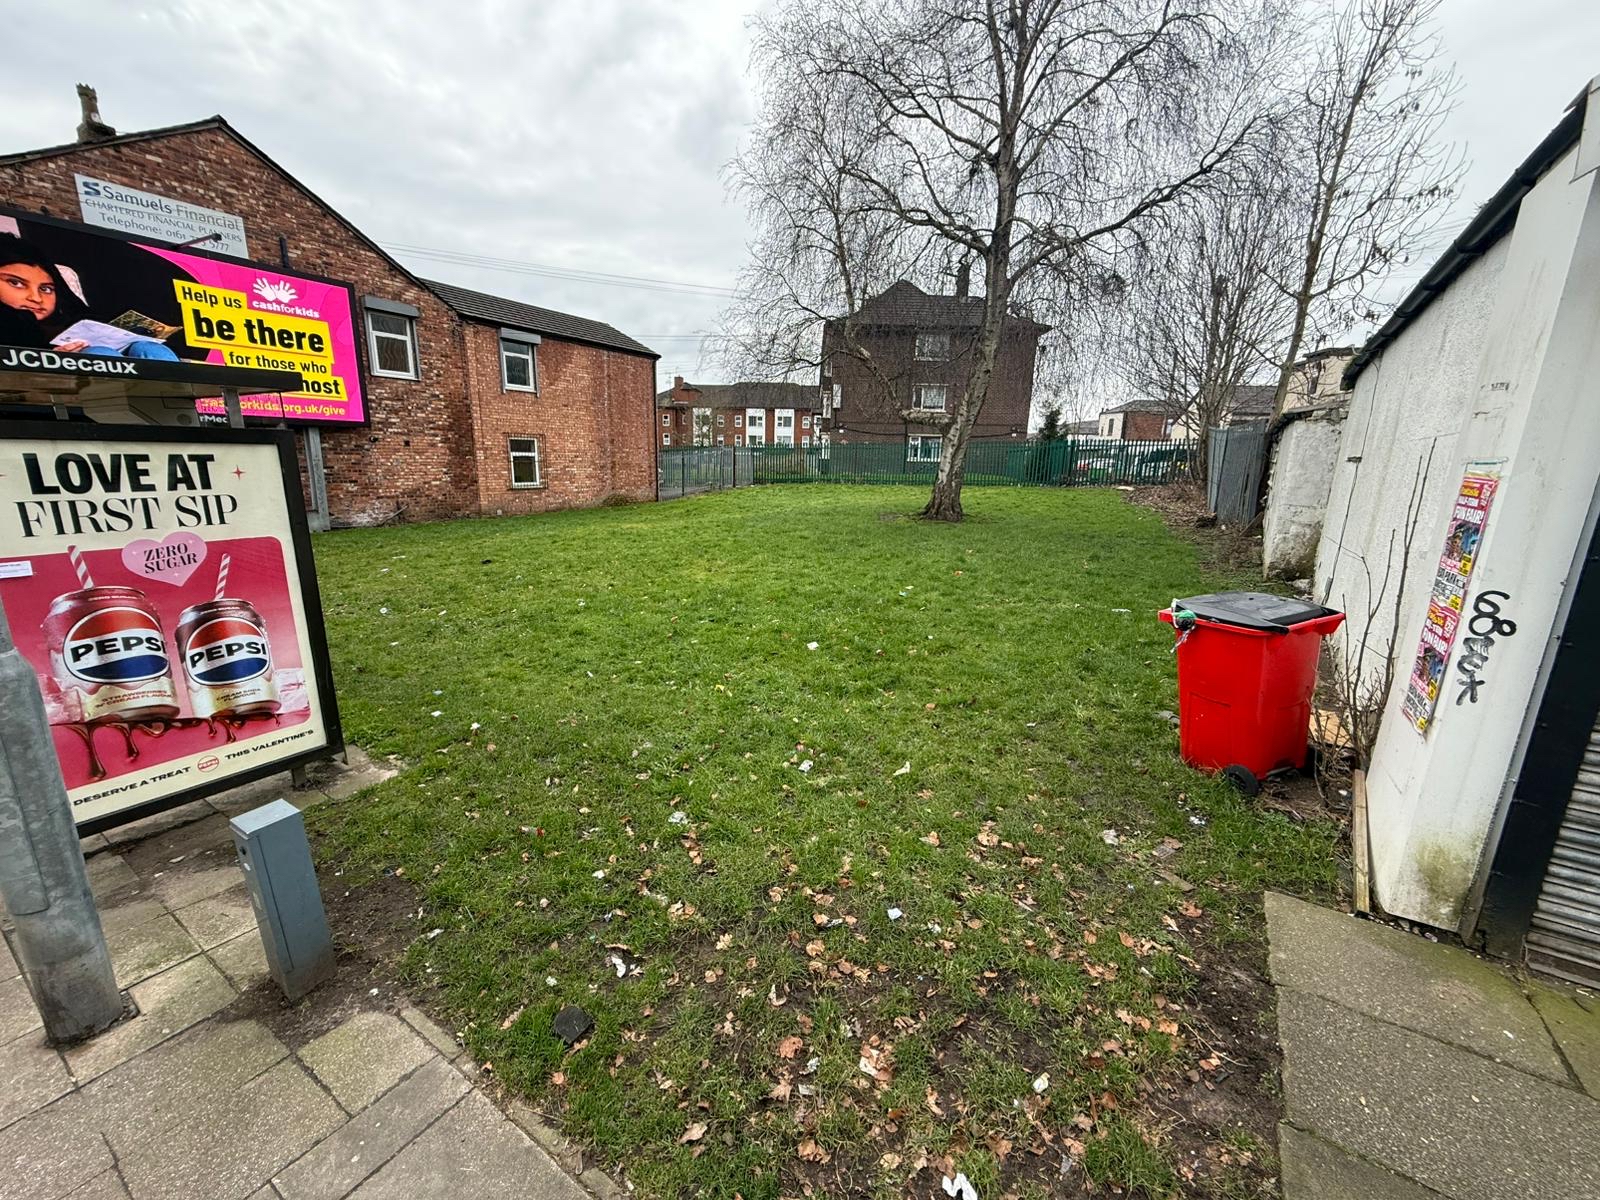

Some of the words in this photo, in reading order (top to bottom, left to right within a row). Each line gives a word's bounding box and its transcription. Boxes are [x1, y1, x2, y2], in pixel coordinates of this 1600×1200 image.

[85, 199, 144, 219] CHARTERED
[147, 212, 195, 232] FINANCIAL
[198, 226, 242, 243] PLANERS
[103, 185, 172, 214] Samuels
[176, 204, 241, 232] Financial
[99, 212, 162, 235] Telephone:
[166, 230, 186, 240] 0161
[181, 286, 218, 308] Help
[223, 296, 242, 309] us
[252, 300, 320, 319] cashforkids
[192, 309, 235, 341] be
[244, 318, 325, 353] there
[2, 349, 138, 375] JCDecaux
[229, 352, 251, 366] for
[256, 355, 296, 371] those
[300, 361, 327, 374] who
[22, 452, 157, 495] LOVE
[167, 454, 215, 491] AT
[14, 497, 161, 538] FIRST
[174, 494, 238, 528] SIP
[143, 542, 188, 562] ZERO
[144, 557, 198, 574] SUGAR
[70, 636, 167, 663] PEPSI
[189, 641, 267, 668] PEPSI
[225, 749, 250, 760] THIS
[252, 729, 314, 752] VALENTINE'S
[73, 782, 138, 806] DESERVE
[150, 766, 191, 783] TREAT
